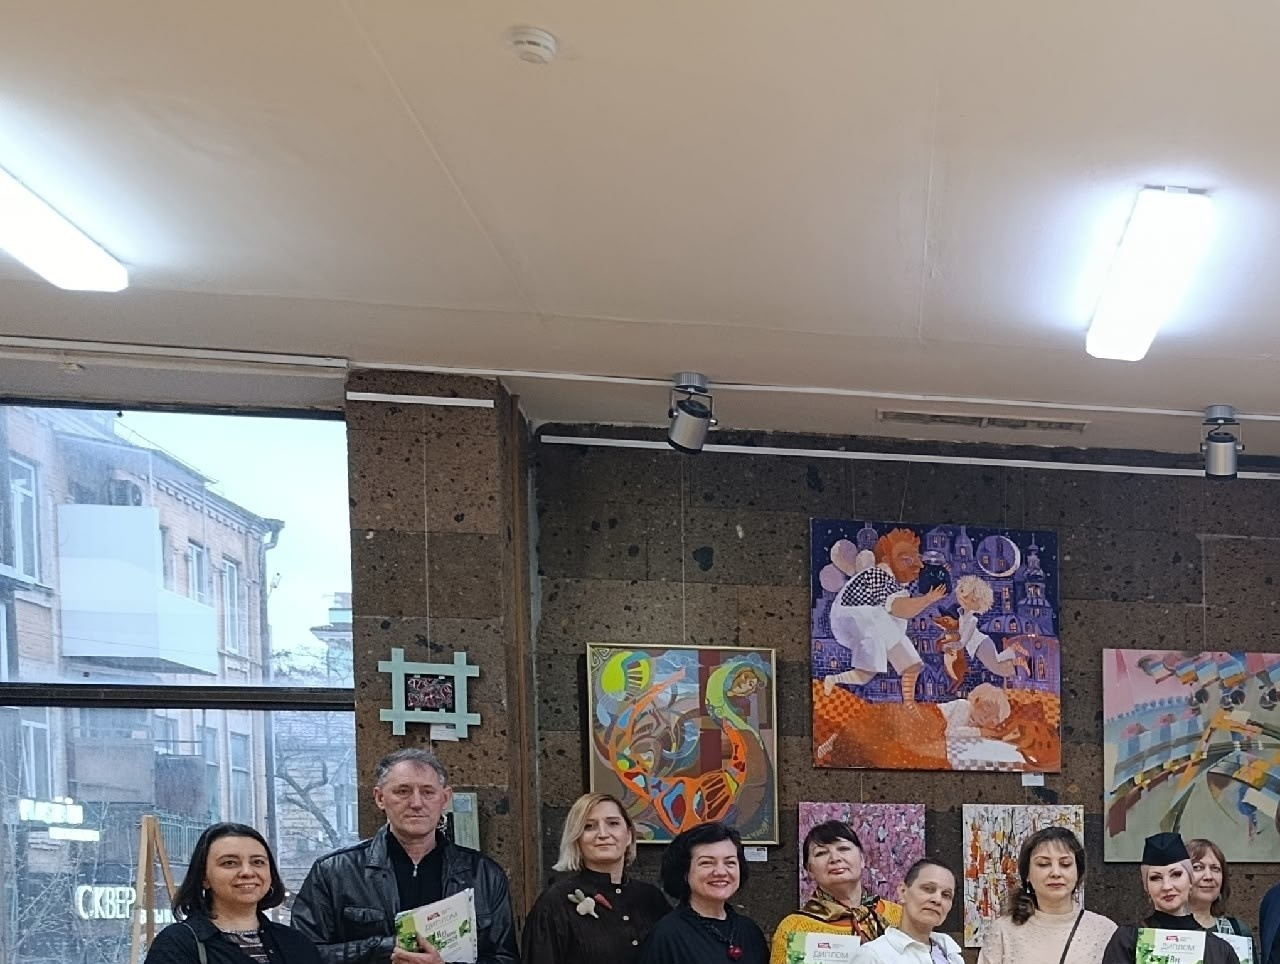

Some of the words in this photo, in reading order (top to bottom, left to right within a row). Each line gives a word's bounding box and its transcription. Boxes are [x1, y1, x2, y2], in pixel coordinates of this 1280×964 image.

[75, 885, 137, 919] СКВЕР
[1161, 942, 1195, 951] ДИПЛОМ
[812, 951, 849, 959] ДИПЛОМ
